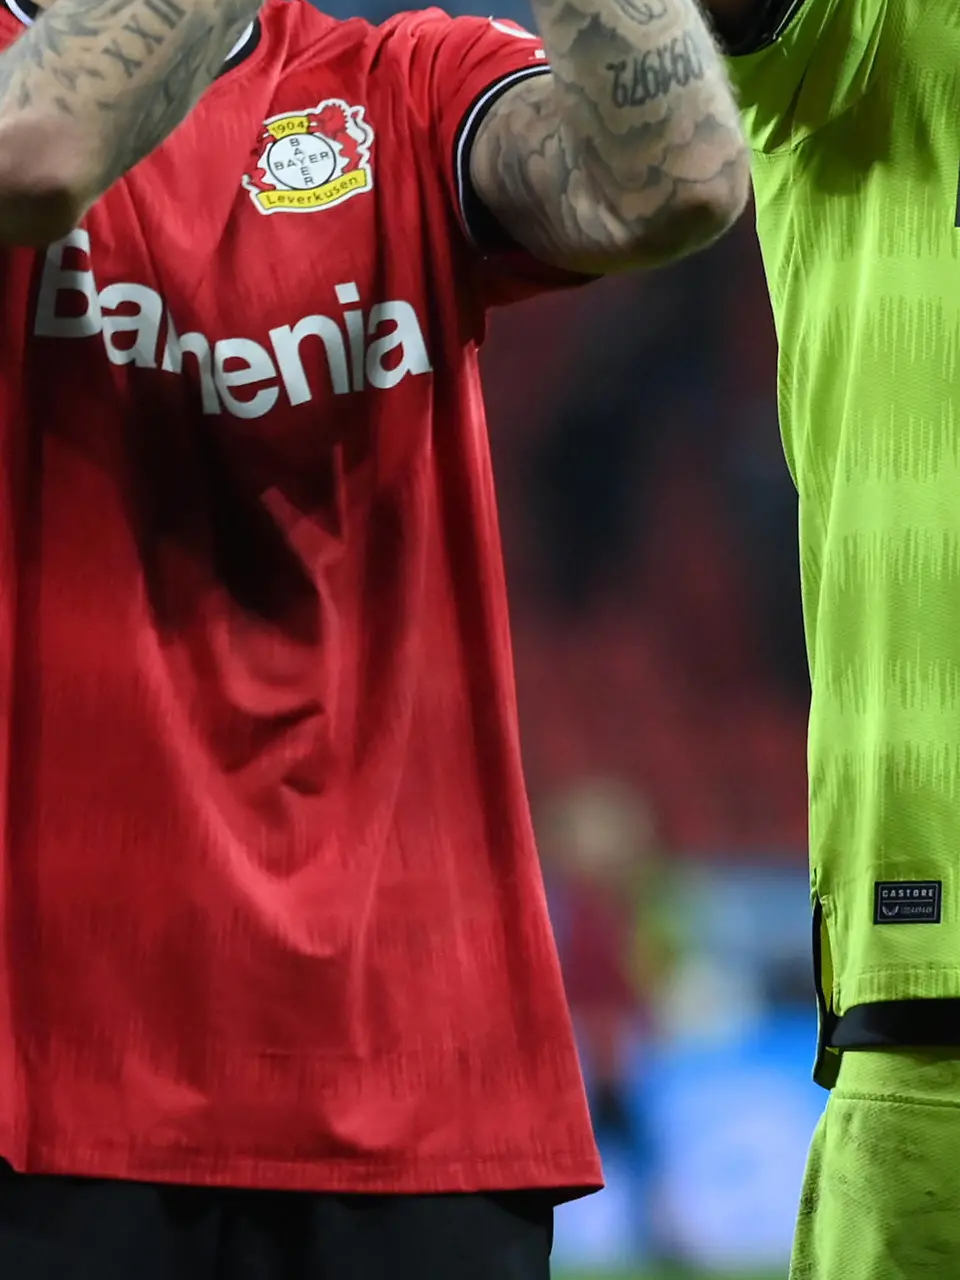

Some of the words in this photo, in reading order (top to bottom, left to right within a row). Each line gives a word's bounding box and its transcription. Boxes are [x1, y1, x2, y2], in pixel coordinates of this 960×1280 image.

[272, 121, 305, 134] 1904
[273, 151, 330, 171] BAYER
[289, 137, 315, 186] BAYER
[265, 176, 359, 205] Leverkusen
[881, 889, 934, 898] CASTORE
